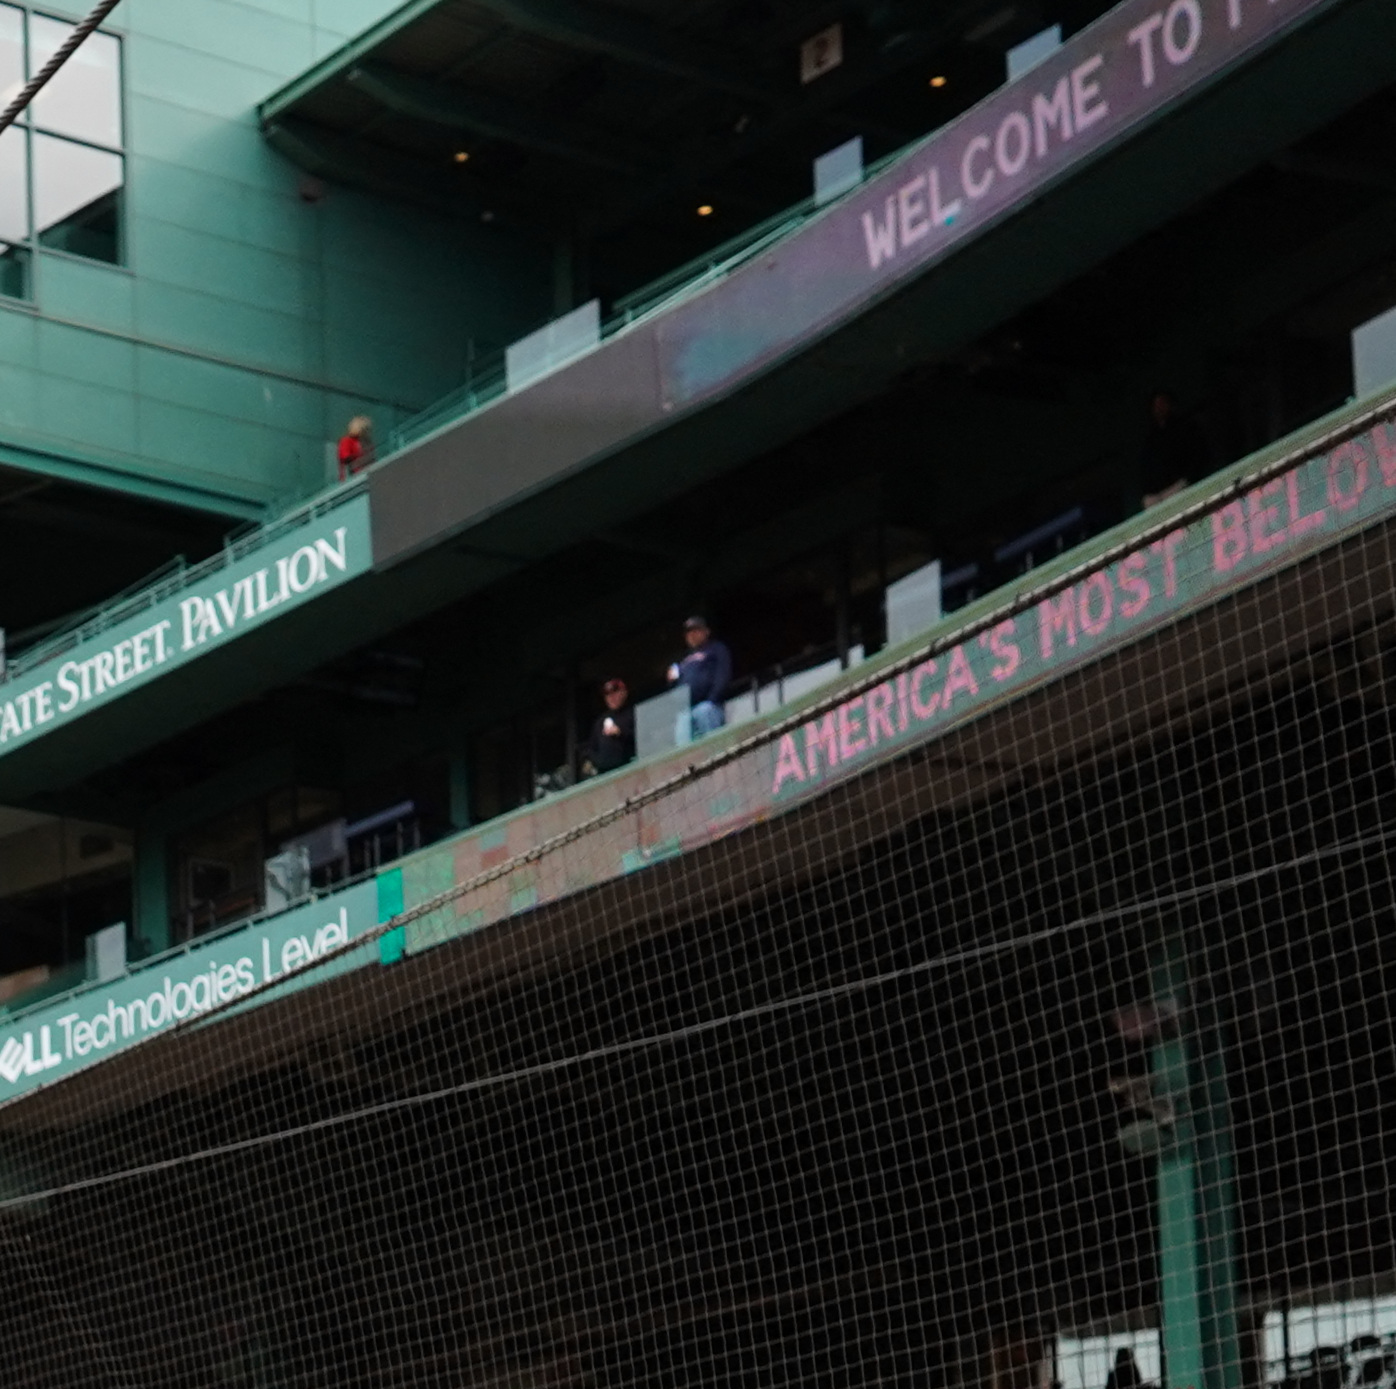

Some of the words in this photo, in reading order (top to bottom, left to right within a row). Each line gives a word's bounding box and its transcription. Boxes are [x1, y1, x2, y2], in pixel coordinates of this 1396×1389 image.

[861, 54, 1109, 270] WELCOME
[1127, 2, 1202, 89] TO
[56, 619, 171, 714] STREET
[179, 527, 348, 652] PAVILION
[772, 618, 1020, 794] AMERICA'S
[1037, 527, 1187, 660] MOST
[261, 906, 350, 984] Level
